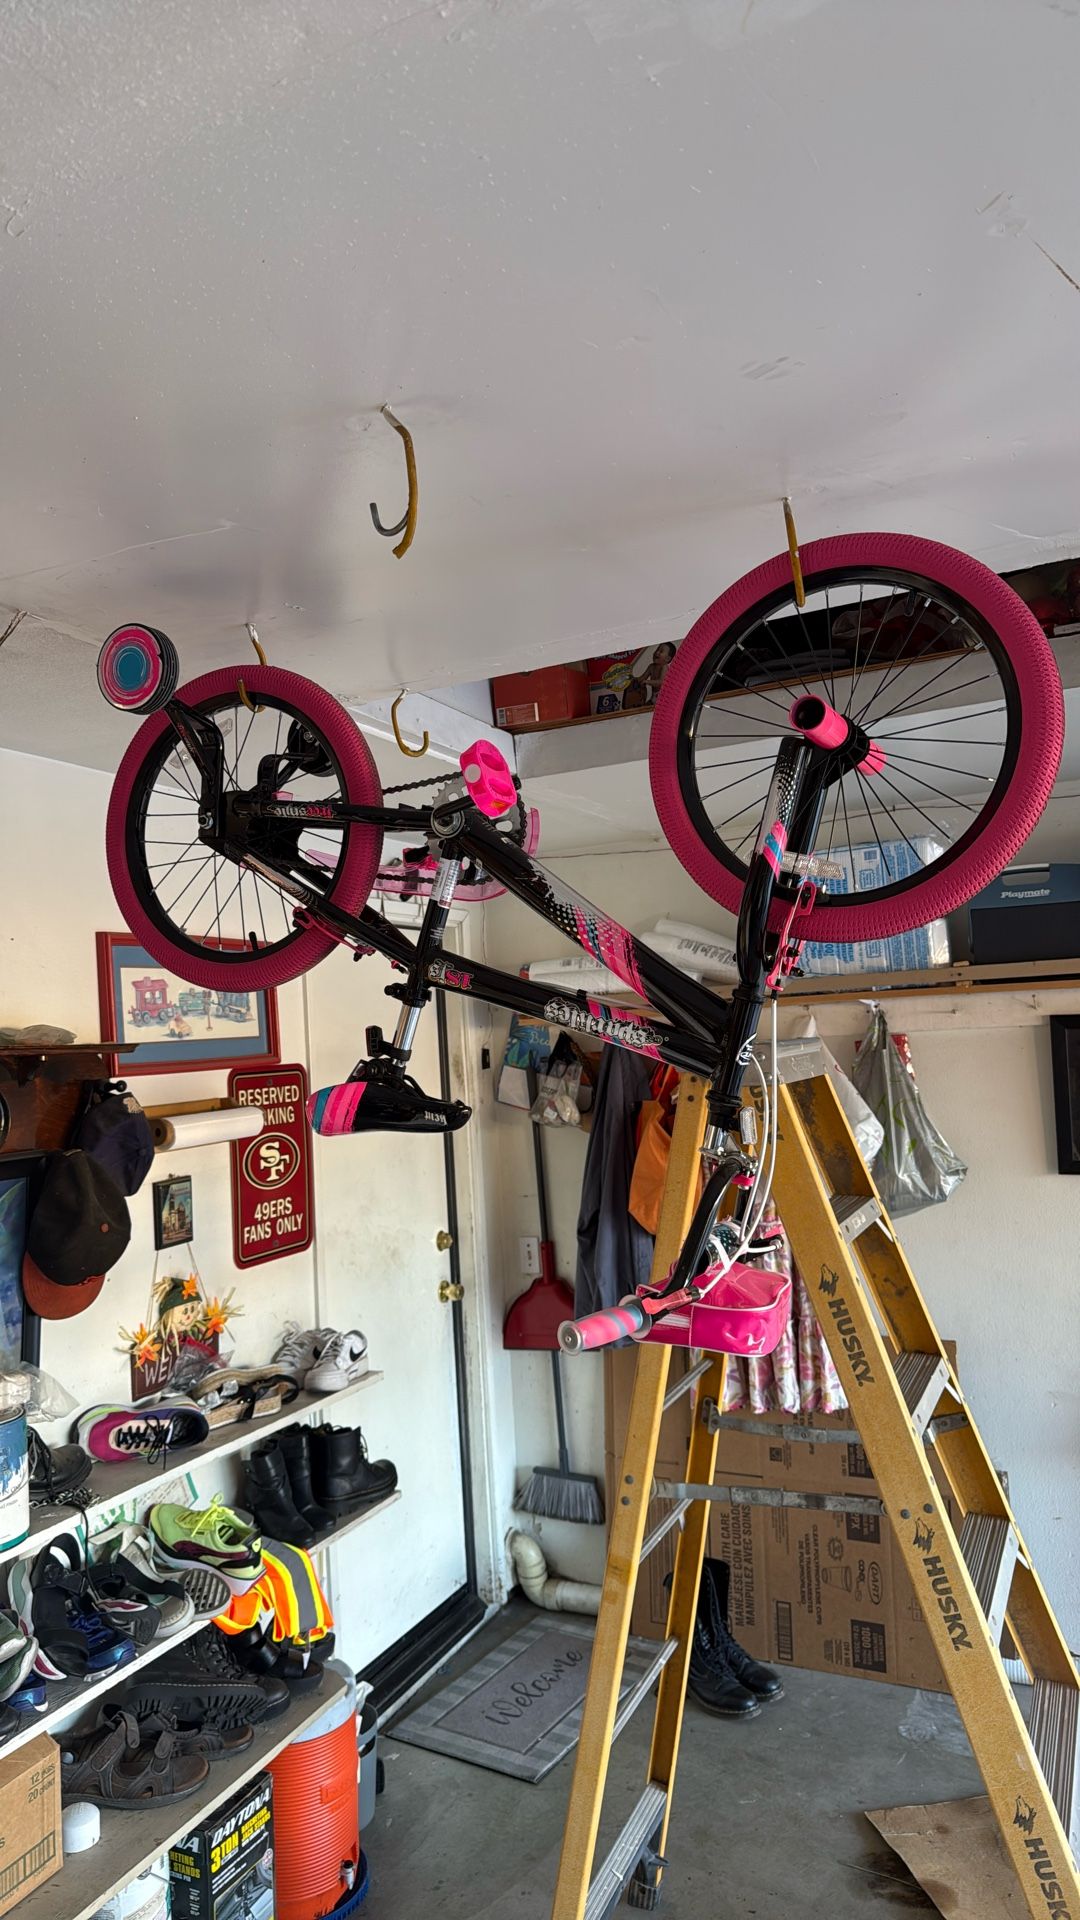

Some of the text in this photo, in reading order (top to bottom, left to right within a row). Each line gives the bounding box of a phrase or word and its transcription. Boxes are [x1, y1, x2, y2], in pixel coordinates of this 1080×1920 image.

[1000, 888, 1051, 899] Playmate
[238, 1084, 299, 1106] RESERVED
[253, 1197, 293, 1222] 49ERS
[243, 1212, 304, 1245] FANS ONLY
[828, 1298, 875, 1386] HUSKY
[720, 1512, 731, 1539] CARE
[732, 1548, 742, 1570] CON
[743, 1538, 753, 1565] AVEC
[870, 1564, 880, 1601] DART
[743, 1566, 756, 1627] MANIPULEZ
[922, 1555, 974, 1651] HUSKY
[861, 1626, 871, 1648] 1000
[481, 1648, 583, 1726] Welcome
[30, 1770, 40, 1786] 12
[27, 1787, 39, 1804] 20
[211, 1787, 270, 1849] DAYTONA
[211, 1831, 239, 1874] 3 TON
[173, 1862, 201, 1879] STANDS
[1023, 1837, 1072, 1920] HUSK
